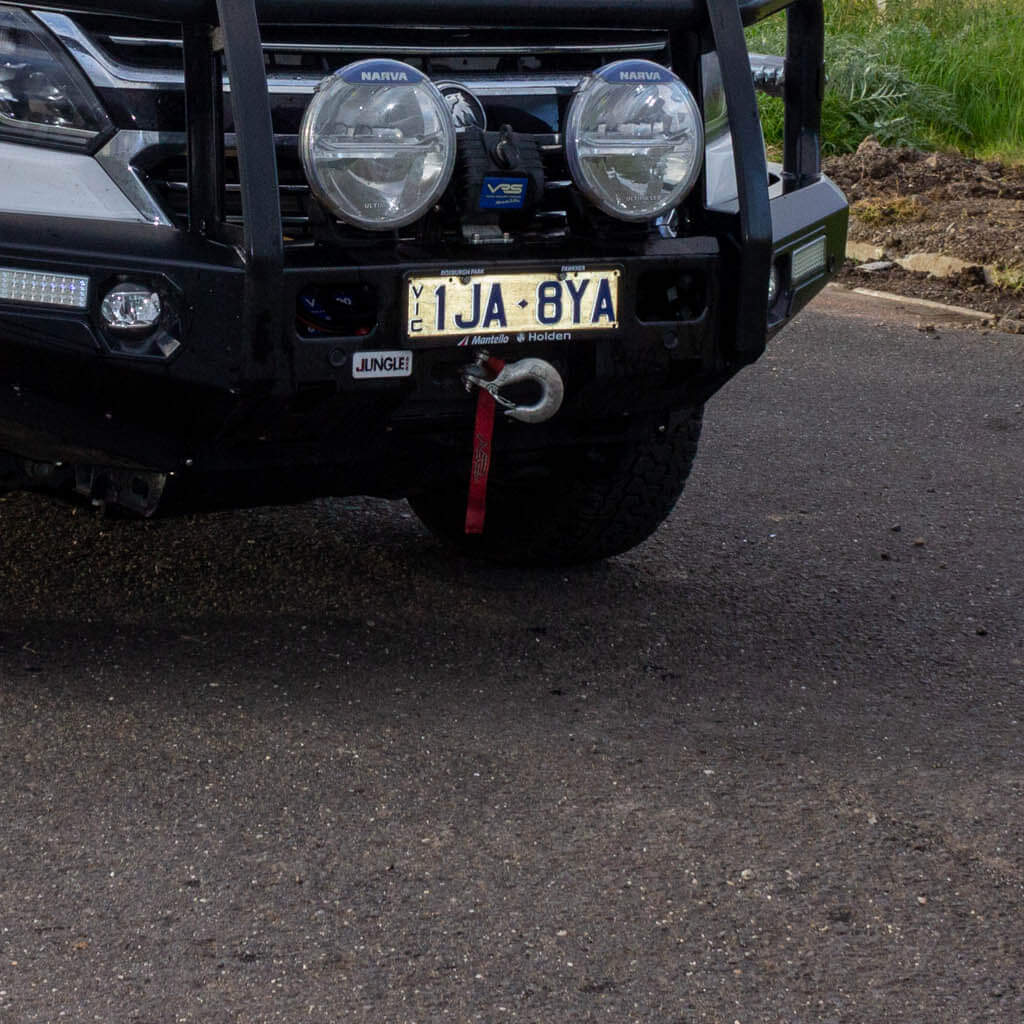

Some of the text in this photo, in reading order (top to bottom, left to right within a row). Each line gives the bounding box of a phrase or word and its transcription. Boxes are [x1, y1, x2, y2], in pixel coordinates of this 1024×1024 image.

[361, 72, 408, 81] NARVA
[619, 72, 661, 81] NARVA
[487, 183, 523, 194] VRS
[410, 285, 423, 332] VIC
[472, 332, 571, 345] Mantello Holden
[356, 357, 405, 372] JUNGLE
